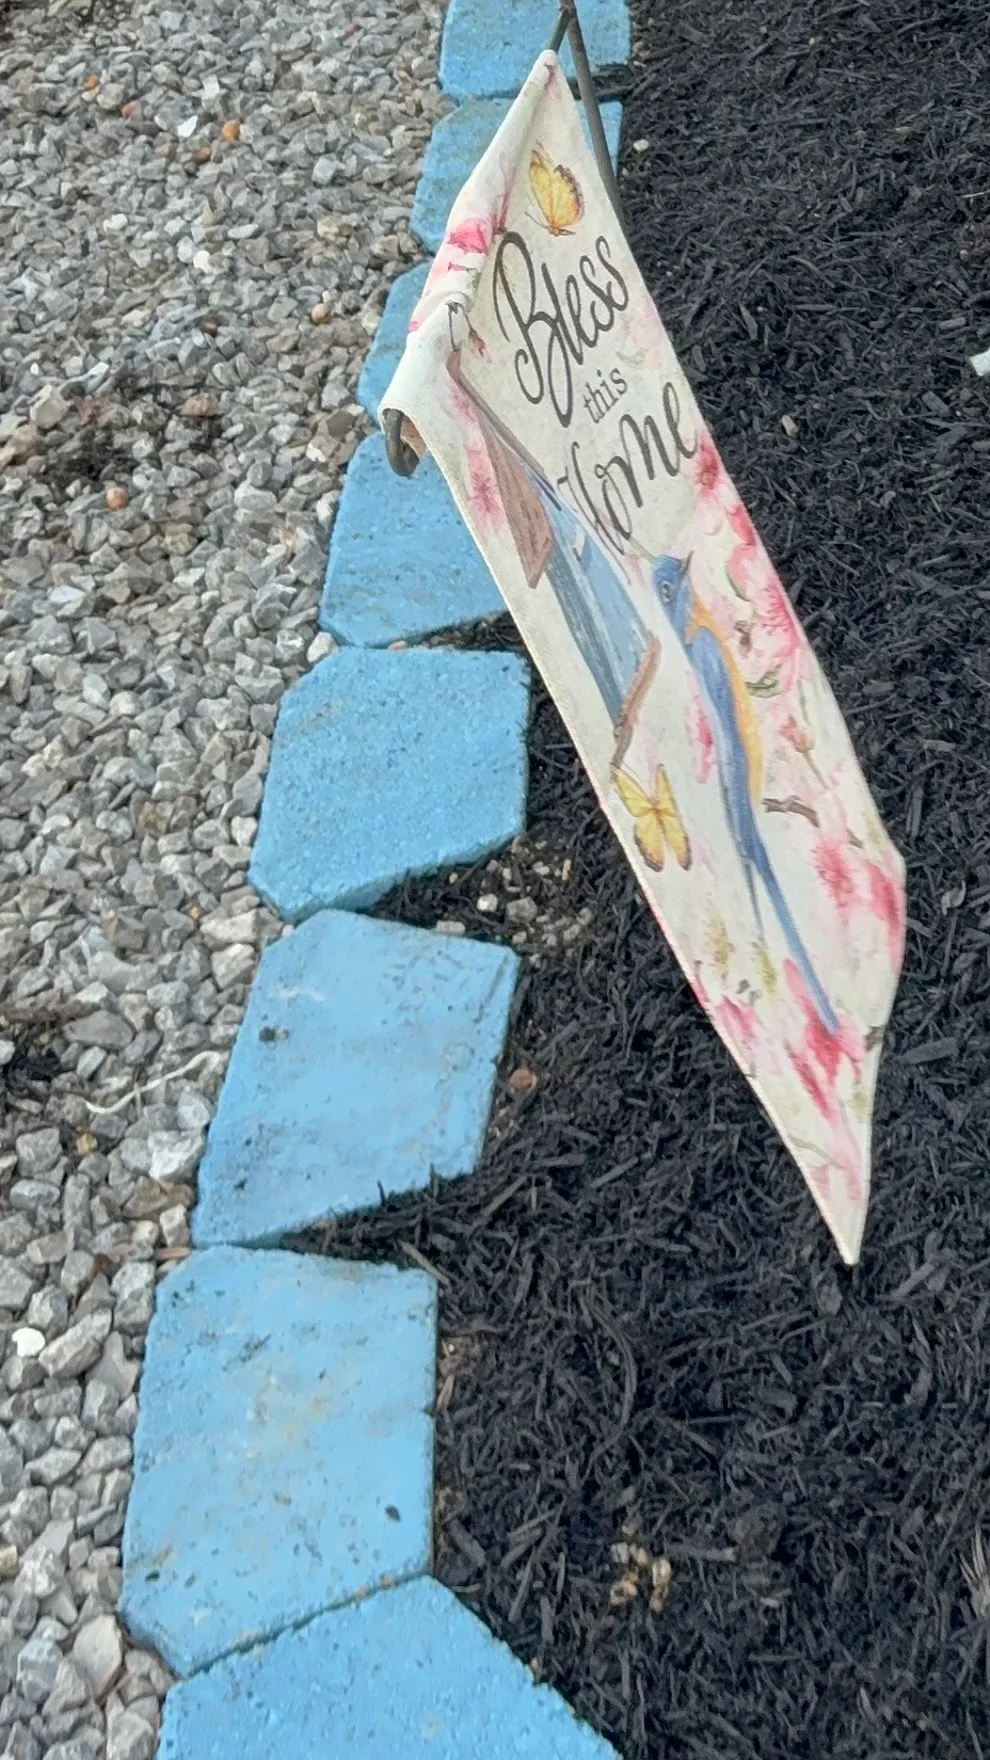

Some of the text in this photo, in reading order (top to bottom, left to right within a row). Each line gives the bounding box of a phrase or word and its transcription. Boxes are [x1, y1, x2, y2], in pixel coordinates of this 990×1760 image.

[493, 231, 629, 428] Bless
[583, 367, 628, 424] this
[557, 382, 698, 584] Home
